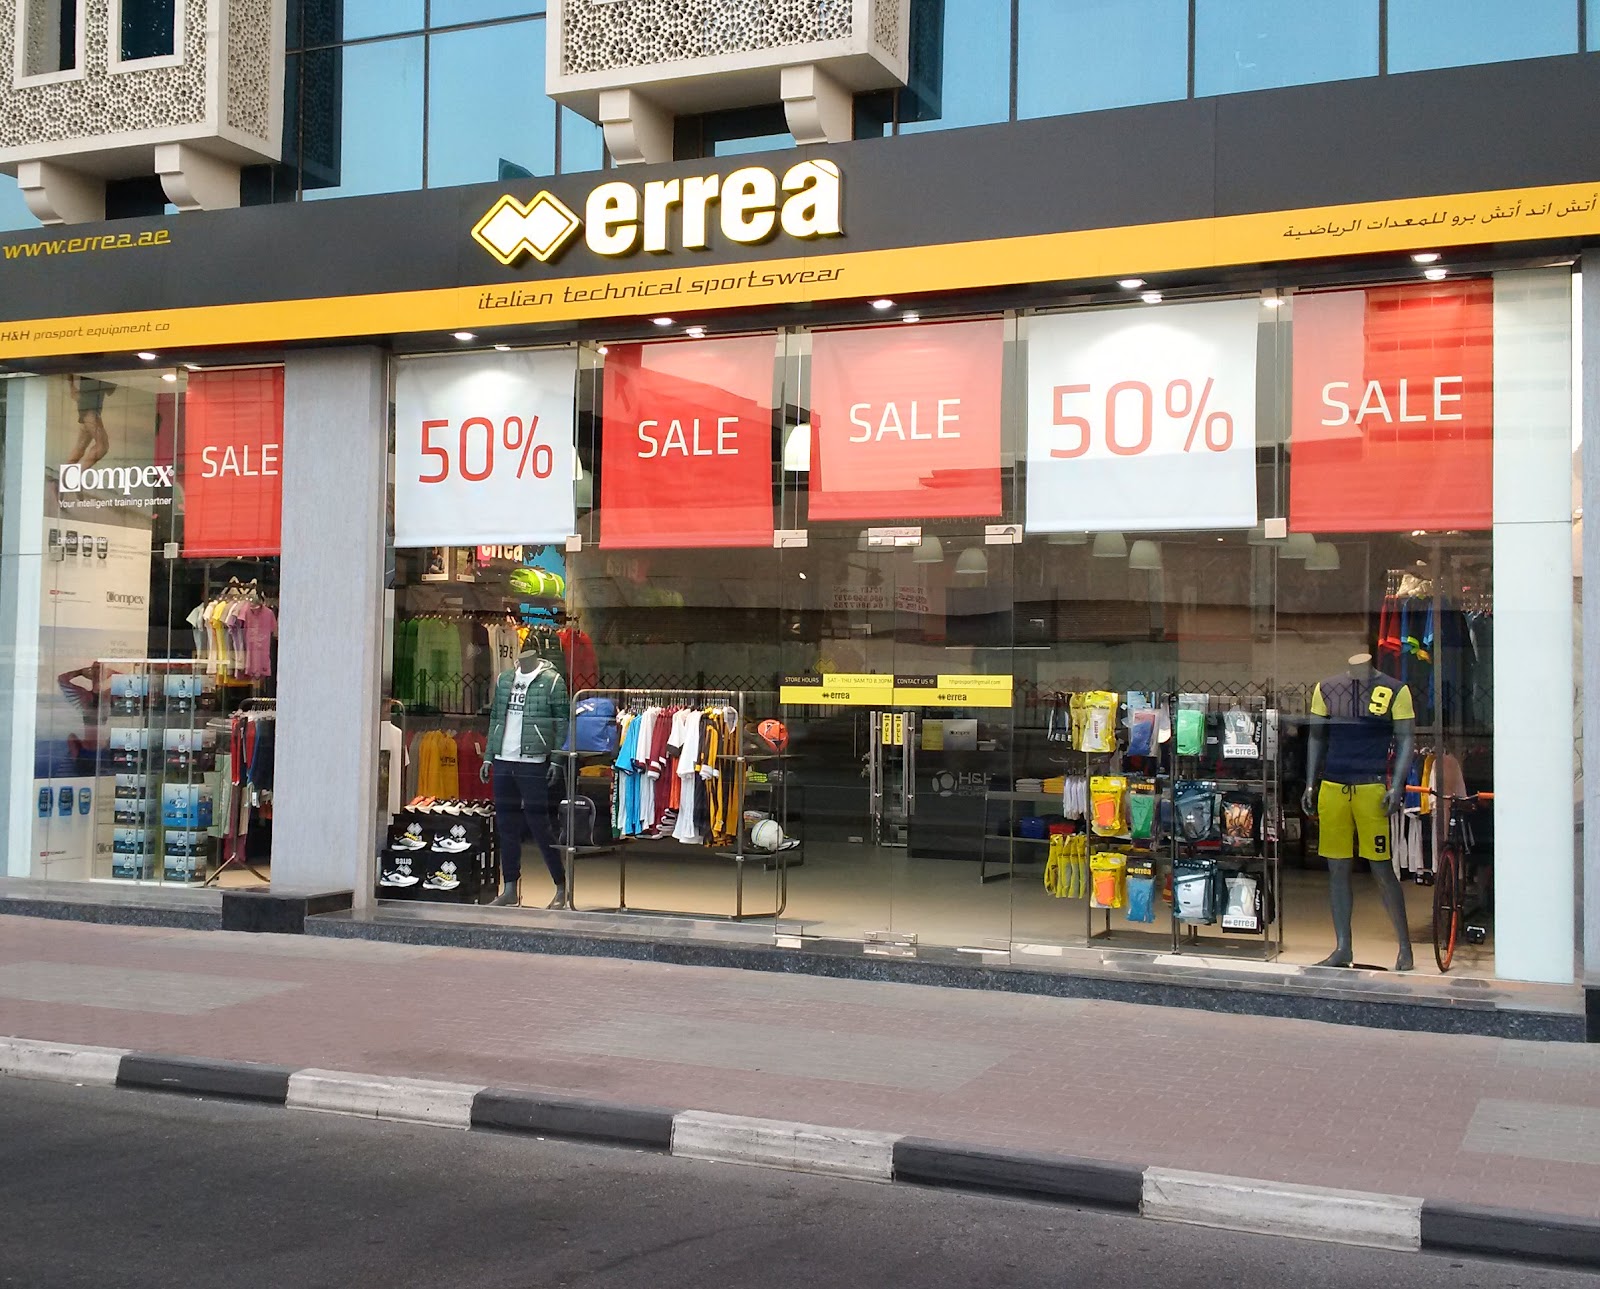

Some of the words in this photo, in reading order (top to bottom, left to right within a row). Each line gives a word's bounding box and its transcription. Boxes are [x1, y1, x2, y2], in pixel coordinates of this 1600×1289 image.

[585, 159, 843, 255] errea
[1283, 218, 1362, 240] الرياضية
[1367, 210, 1447, 230] للمعدات
[1452, 211, 1476, 227] برو
[2, 229, 171, 260] www.errea.ae
[478, 291, 553, 310] italian
[564, 277, 683, 304] technical
[687, 268, 845, 294] sportswear
[1, 329, 30, 342] H&H
[33, 325, 84, 342] prosport
[86, 322, 152, 338] equipment
[155, 322, 170, 332] co
[1320, 375, 1463, 426] SALE
[849, 398, 961, 443] SALE
[1050, 377, 1234, 459] 50%
[638, 416, 739, 459] SALE
[418, 415, 553, 484] 50%
[201, 444, 279, 478] SALE
[59, 500, 76, 508] Your
[77, 499, 113, 509] intelligent
[115, 498, 143, 508] training
[144, 497, 172, 507] partner
[106, 591, 145, 605] Compex
[831, 691, 850, 700] errea
[947, 693, 967, 701] errea
[1368, 686, 1394, 716] 9
[1235, 747, 1257, 756] errea
[1374, 835, 1386, 854] 9
[1233, 918, 1255, 928] errea
